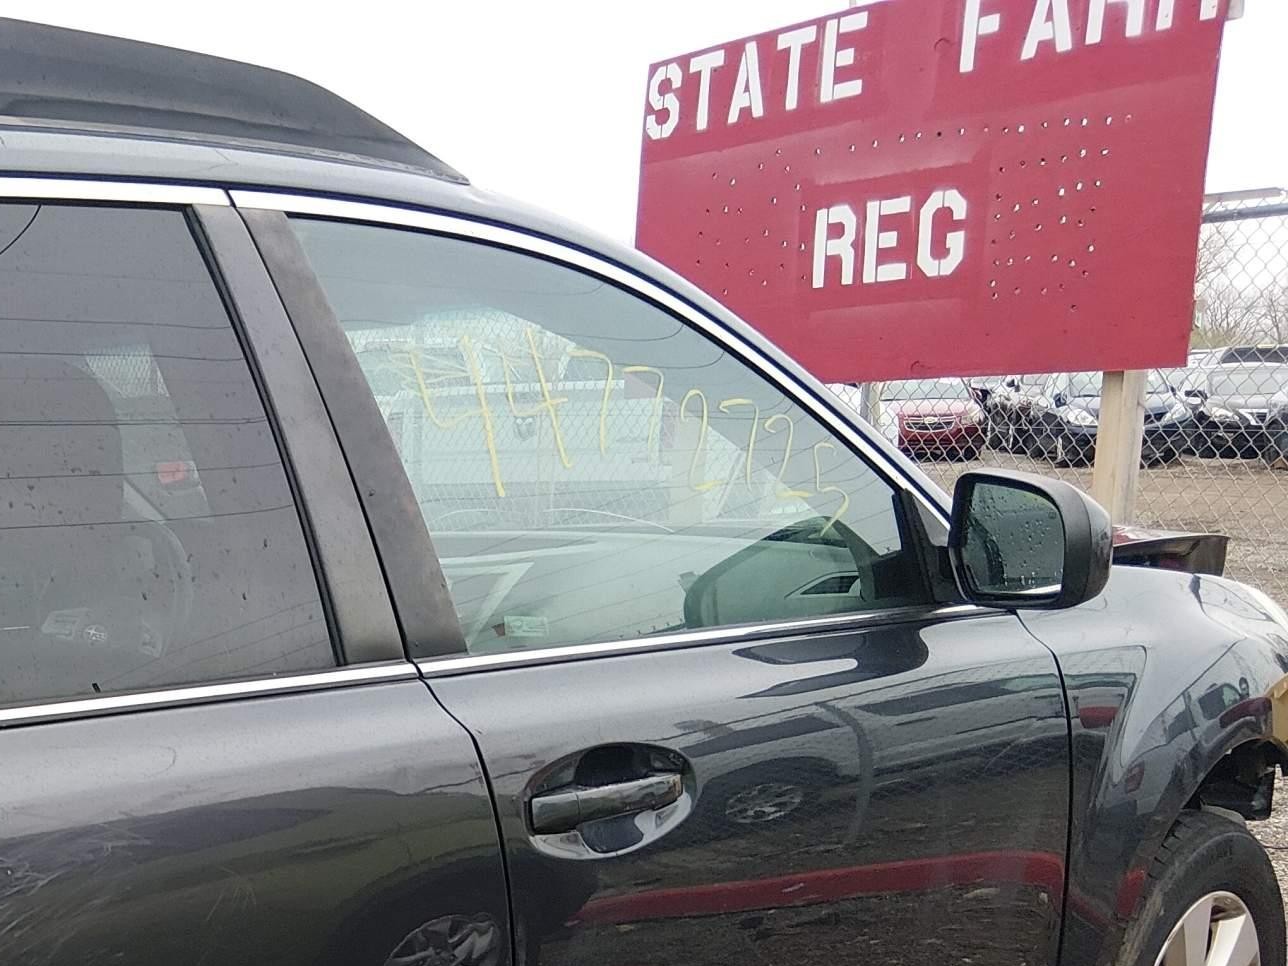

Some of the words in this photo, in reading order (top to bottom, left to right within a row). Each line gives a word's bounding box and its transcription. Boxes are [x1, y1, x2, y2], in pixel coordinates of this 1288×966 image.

[646, 11, 869, 140] STATE
[813, 189, 968, 289] REG
[409, 327, 849, 538] 44772725
